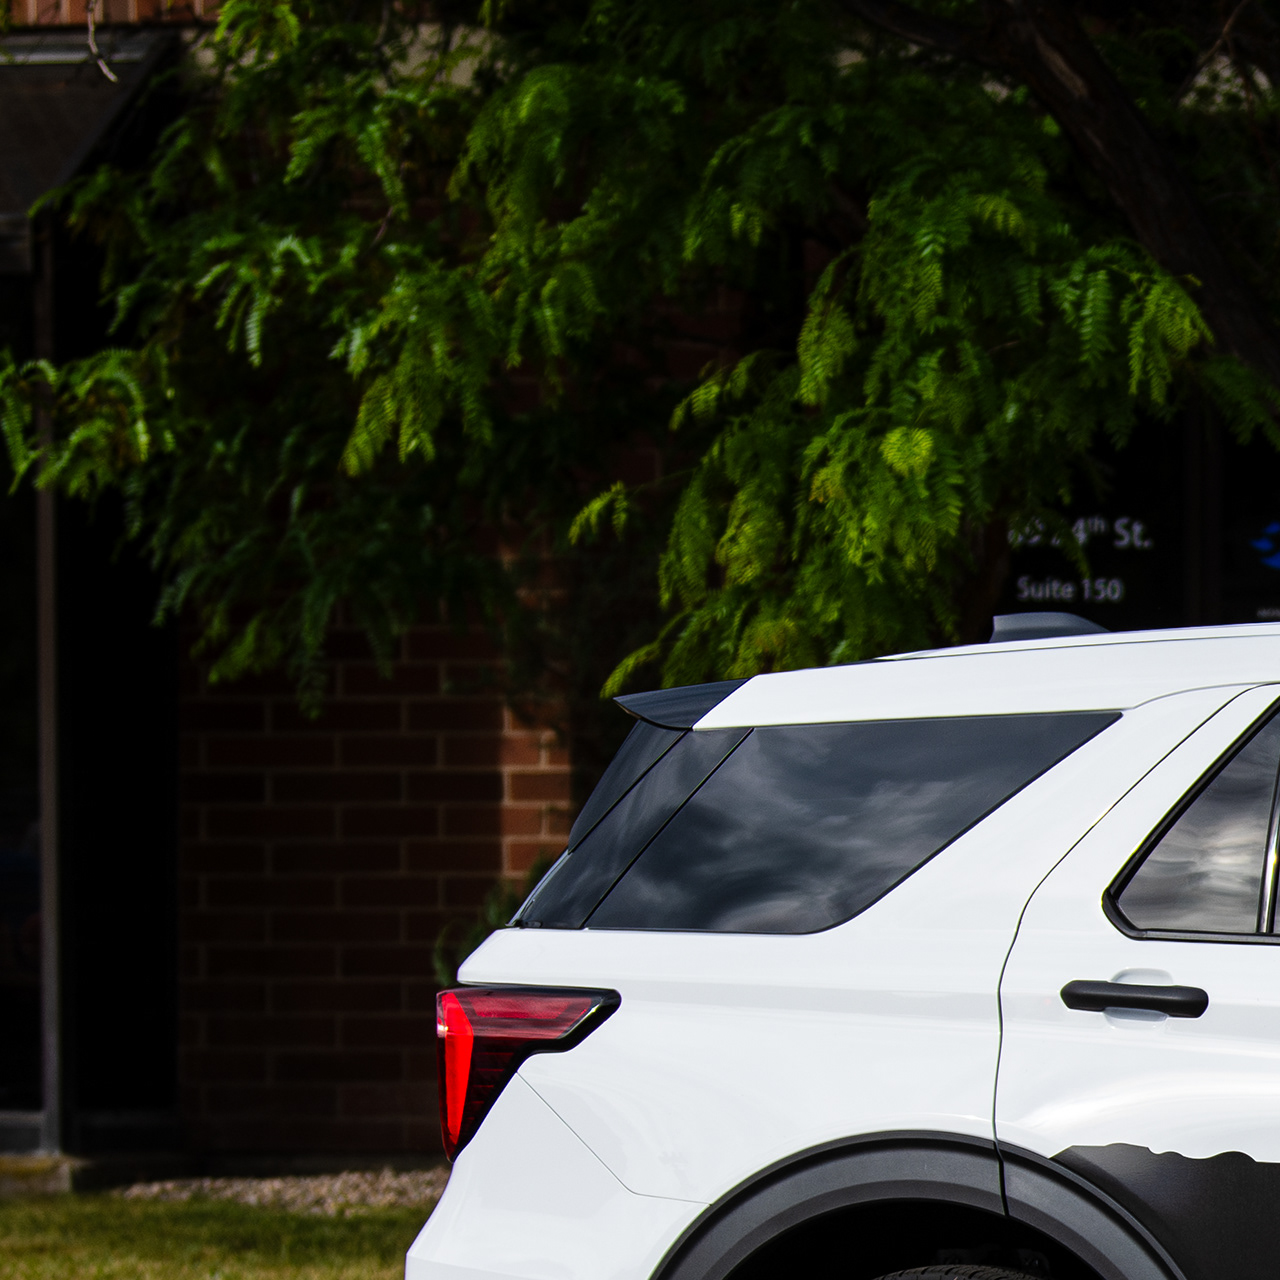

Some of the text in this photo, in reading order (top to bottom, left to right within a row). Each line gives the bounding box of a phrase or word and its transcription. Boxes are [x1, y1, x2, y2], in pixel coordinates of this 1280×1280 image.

[1112, 516, 1154, 549] St.
[1016, 575, 1125, 602] Suite 150
